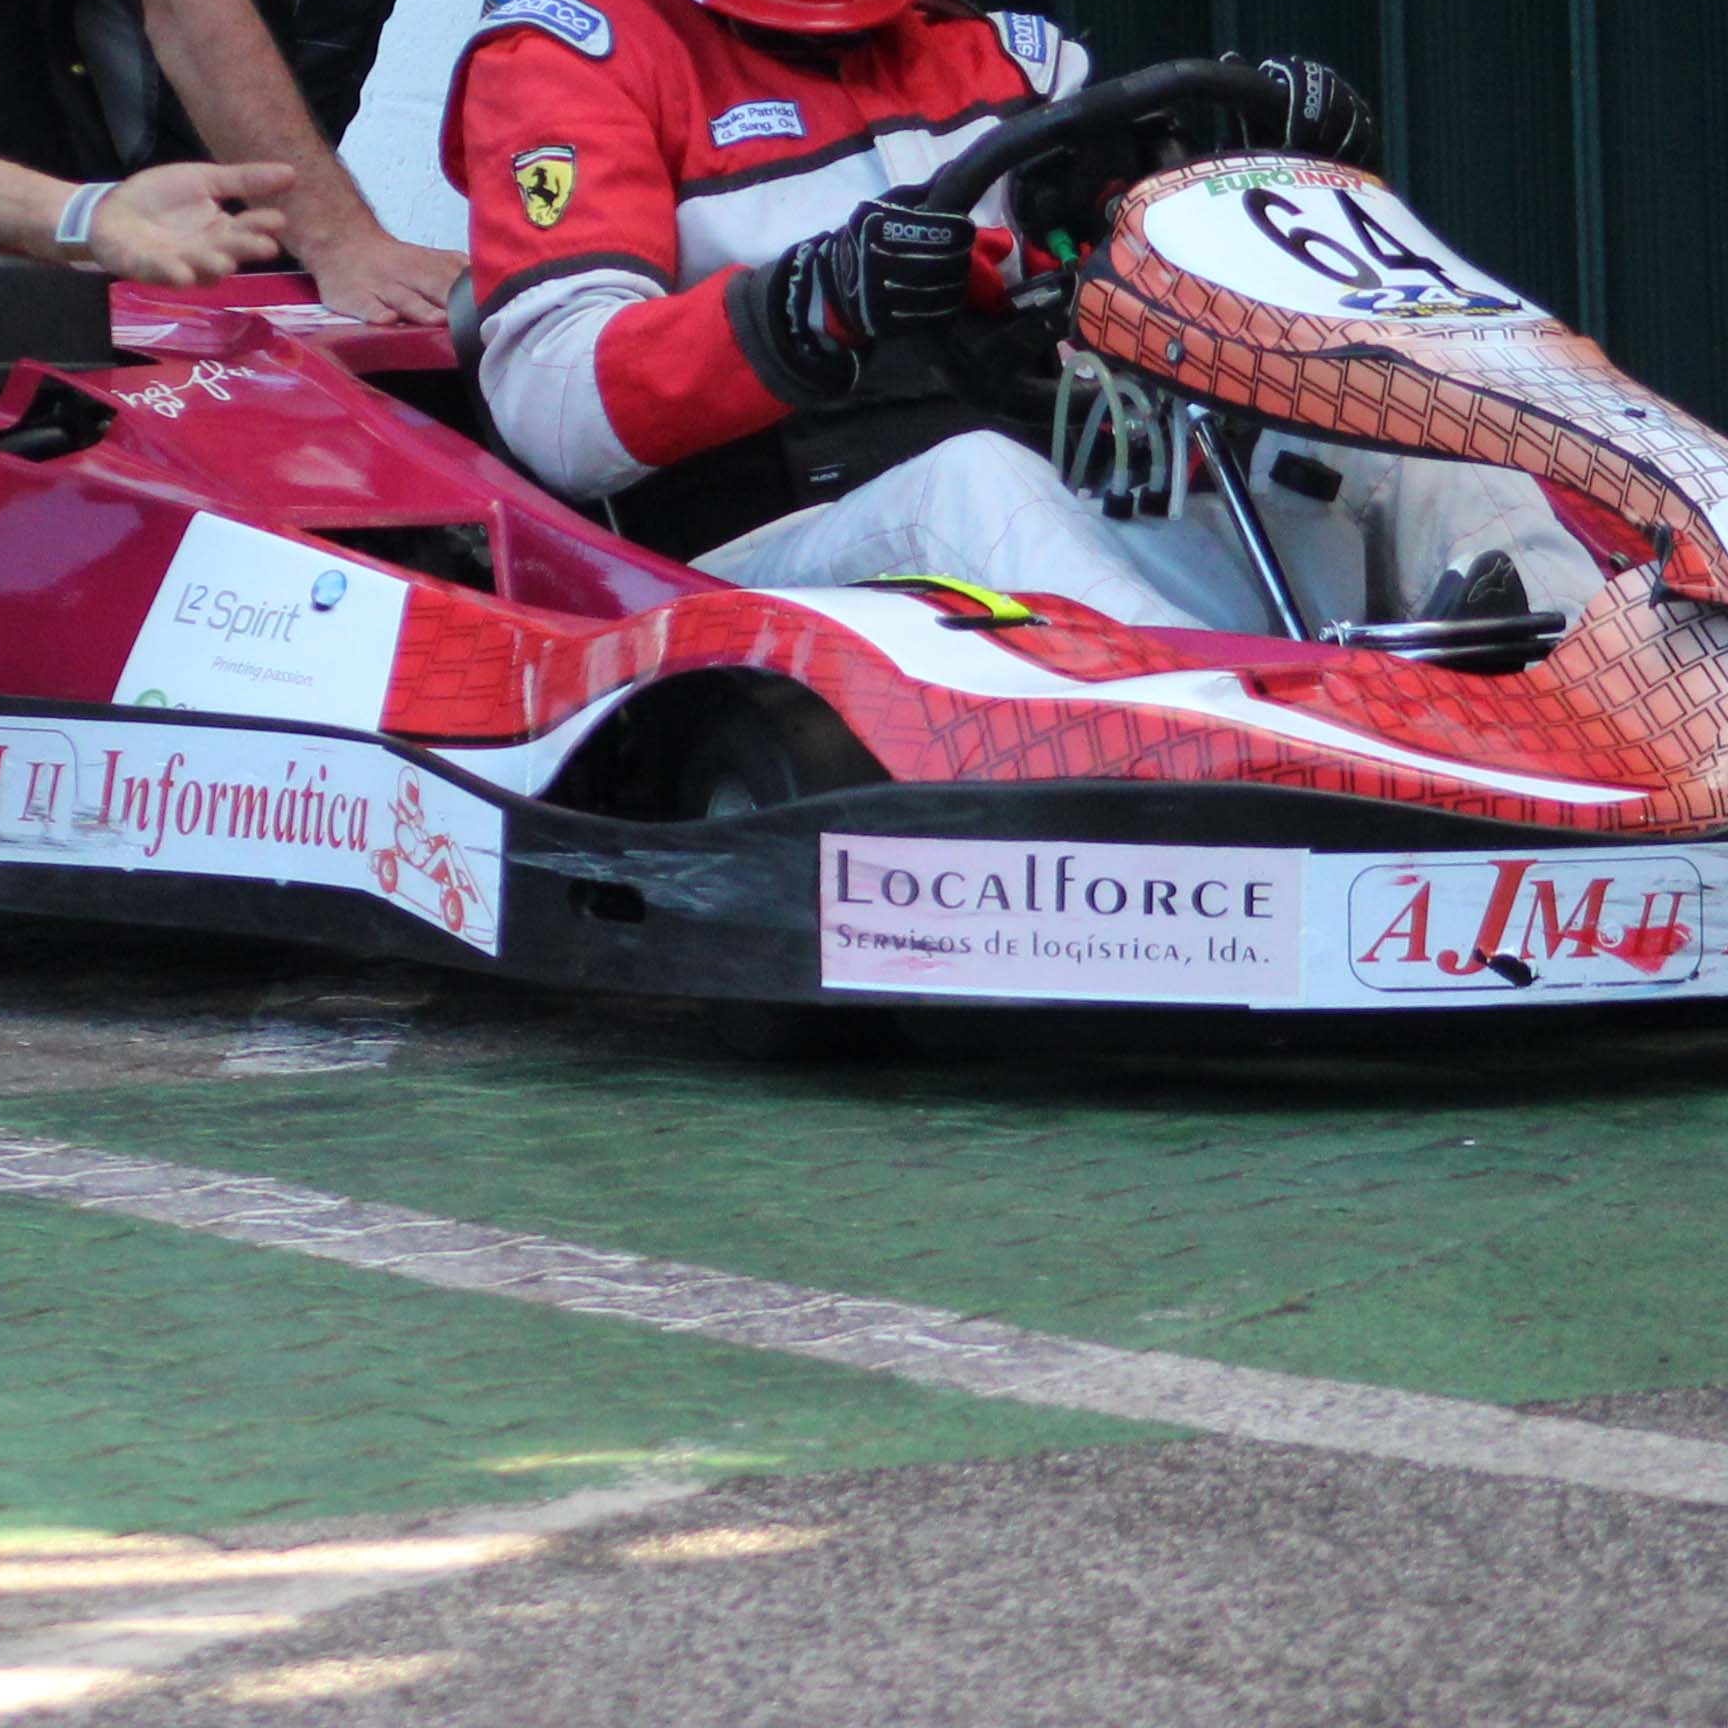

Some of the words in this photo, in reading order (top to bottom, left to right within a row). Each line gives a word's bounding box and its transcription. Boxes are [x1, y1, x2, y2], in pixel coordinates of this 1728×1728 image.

[882, 220, 952, 245] sparco
[1242, 187, 1457, 292] 64
[207, 590, 302, 642] Spirit
[98, 748, 370, 857] Informática
[1356, 858, 1615, 976] AJM
